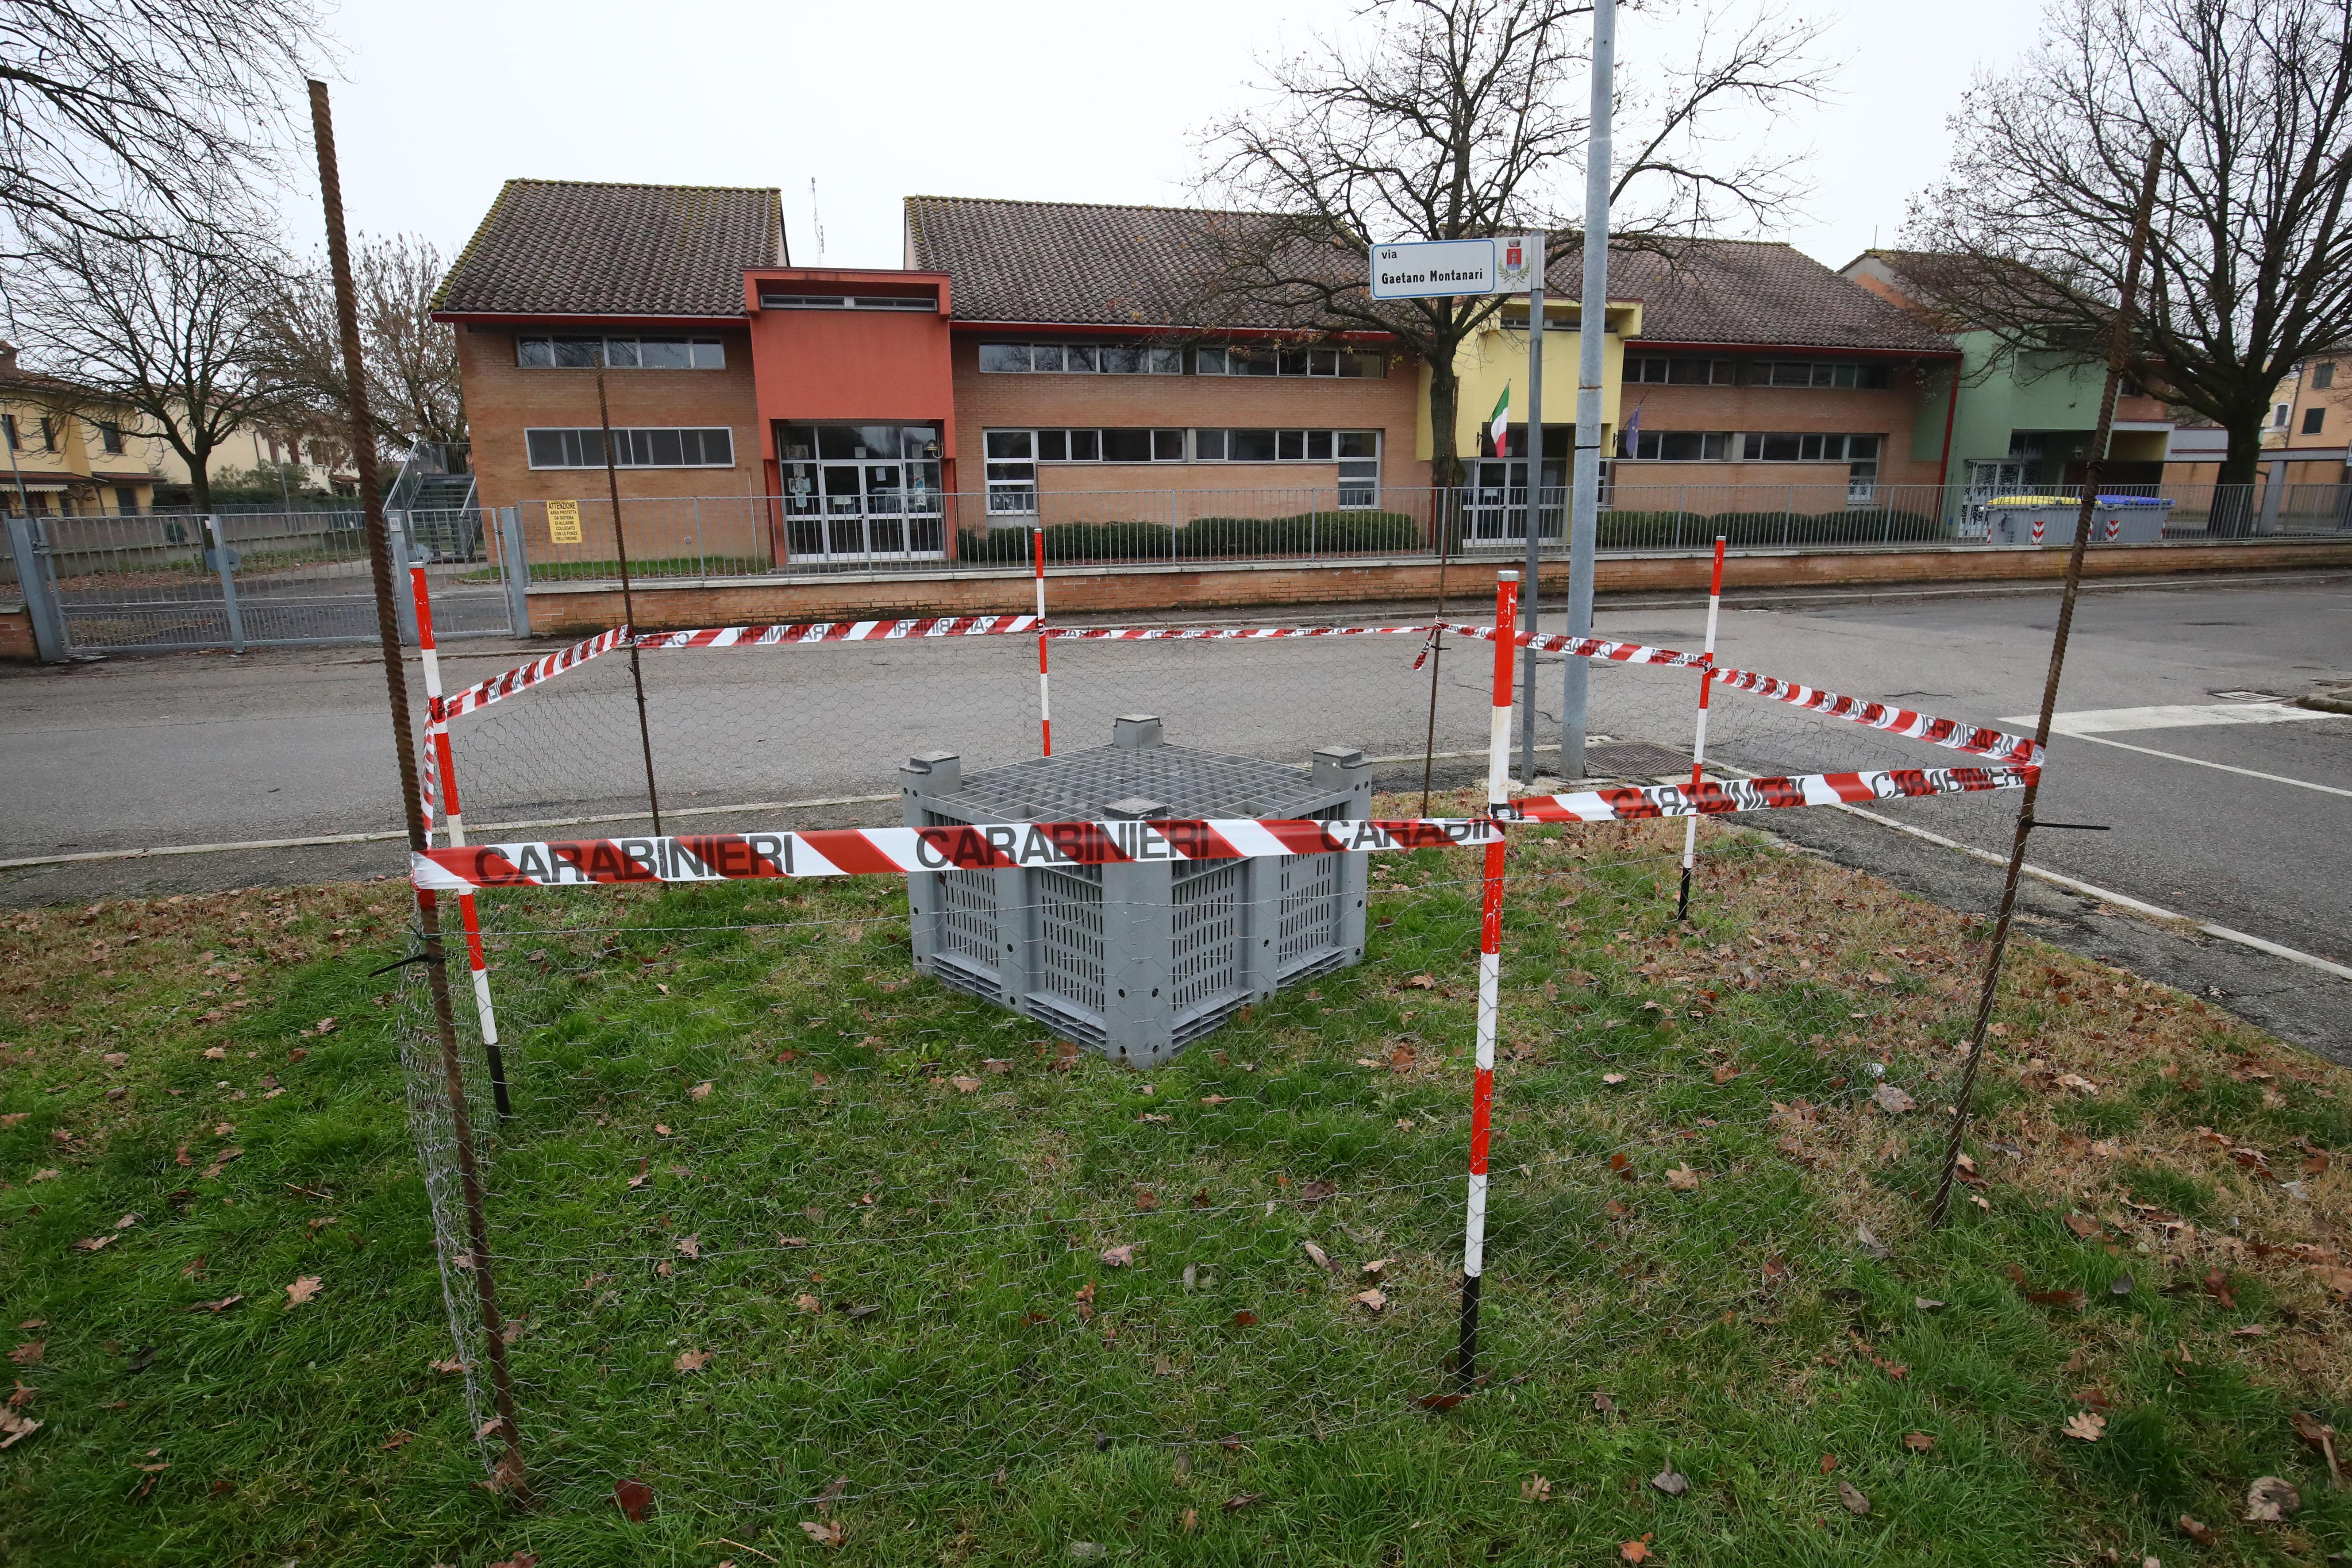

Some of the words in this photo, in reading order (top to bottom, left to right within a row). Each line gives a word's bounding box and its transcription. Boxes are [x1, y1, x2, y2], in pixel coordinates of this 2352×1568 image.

[1382, 249, 1397, 259] via
[1382, 272, 1424, 284] Gaetano
[1430, 268, 1482, 281] Montanari
[1611, 778, 1805, 819] CARABINIERI
[1871, 768, 2025, 798] CARABINIERI
[475, 834, 794, 885] CARABINIERI
[916, 821, 1209, 869] CARABINIERI
